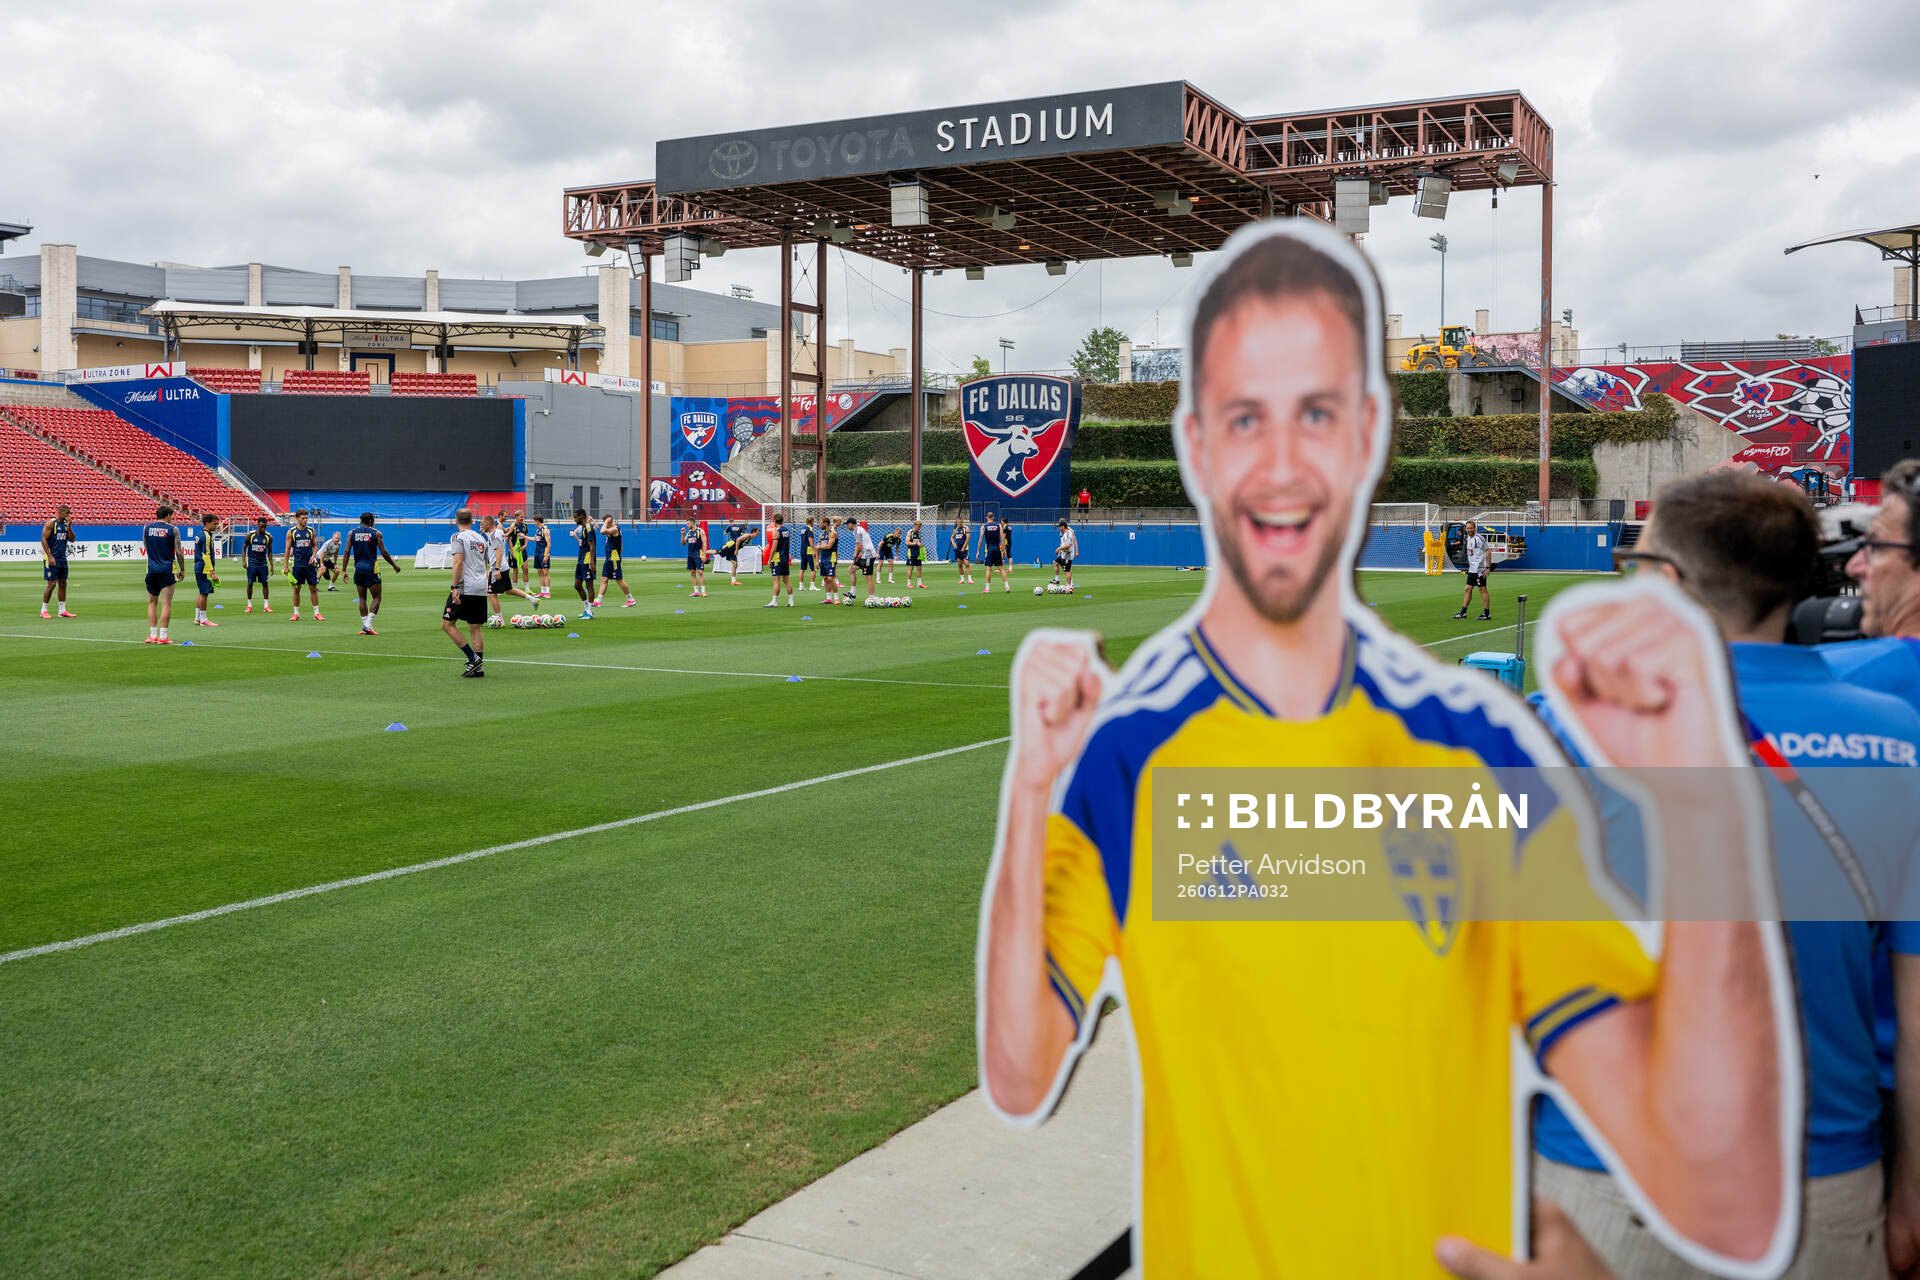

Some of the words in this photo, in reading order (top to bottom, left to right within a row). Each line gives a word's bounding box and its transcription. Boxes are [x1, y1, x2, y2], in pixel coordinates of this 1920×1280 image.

[770, 127, 915, 170] TOYOTA
[936, 103, 1113, 153] STADIUM
[87, 370, 107, 378] ULTRA
[109, 368, 131, 377] ZONE
[622, 380, 640, 388] ULTRA
[124, 391, 157, 404] Michelob
[165, 388, 200, 401] ULTRA
[969, 386, 989, 415] FC
[997, 383, 1061, 412] DALLAS
[683, 414, 691, 425] FC
[692, 414, 715, 424] DALLAS
[688, 488, 726, 501] DTID
[1, 548, 37, 556] MERICA
[111, 543, 135, 557] 蒙牛
